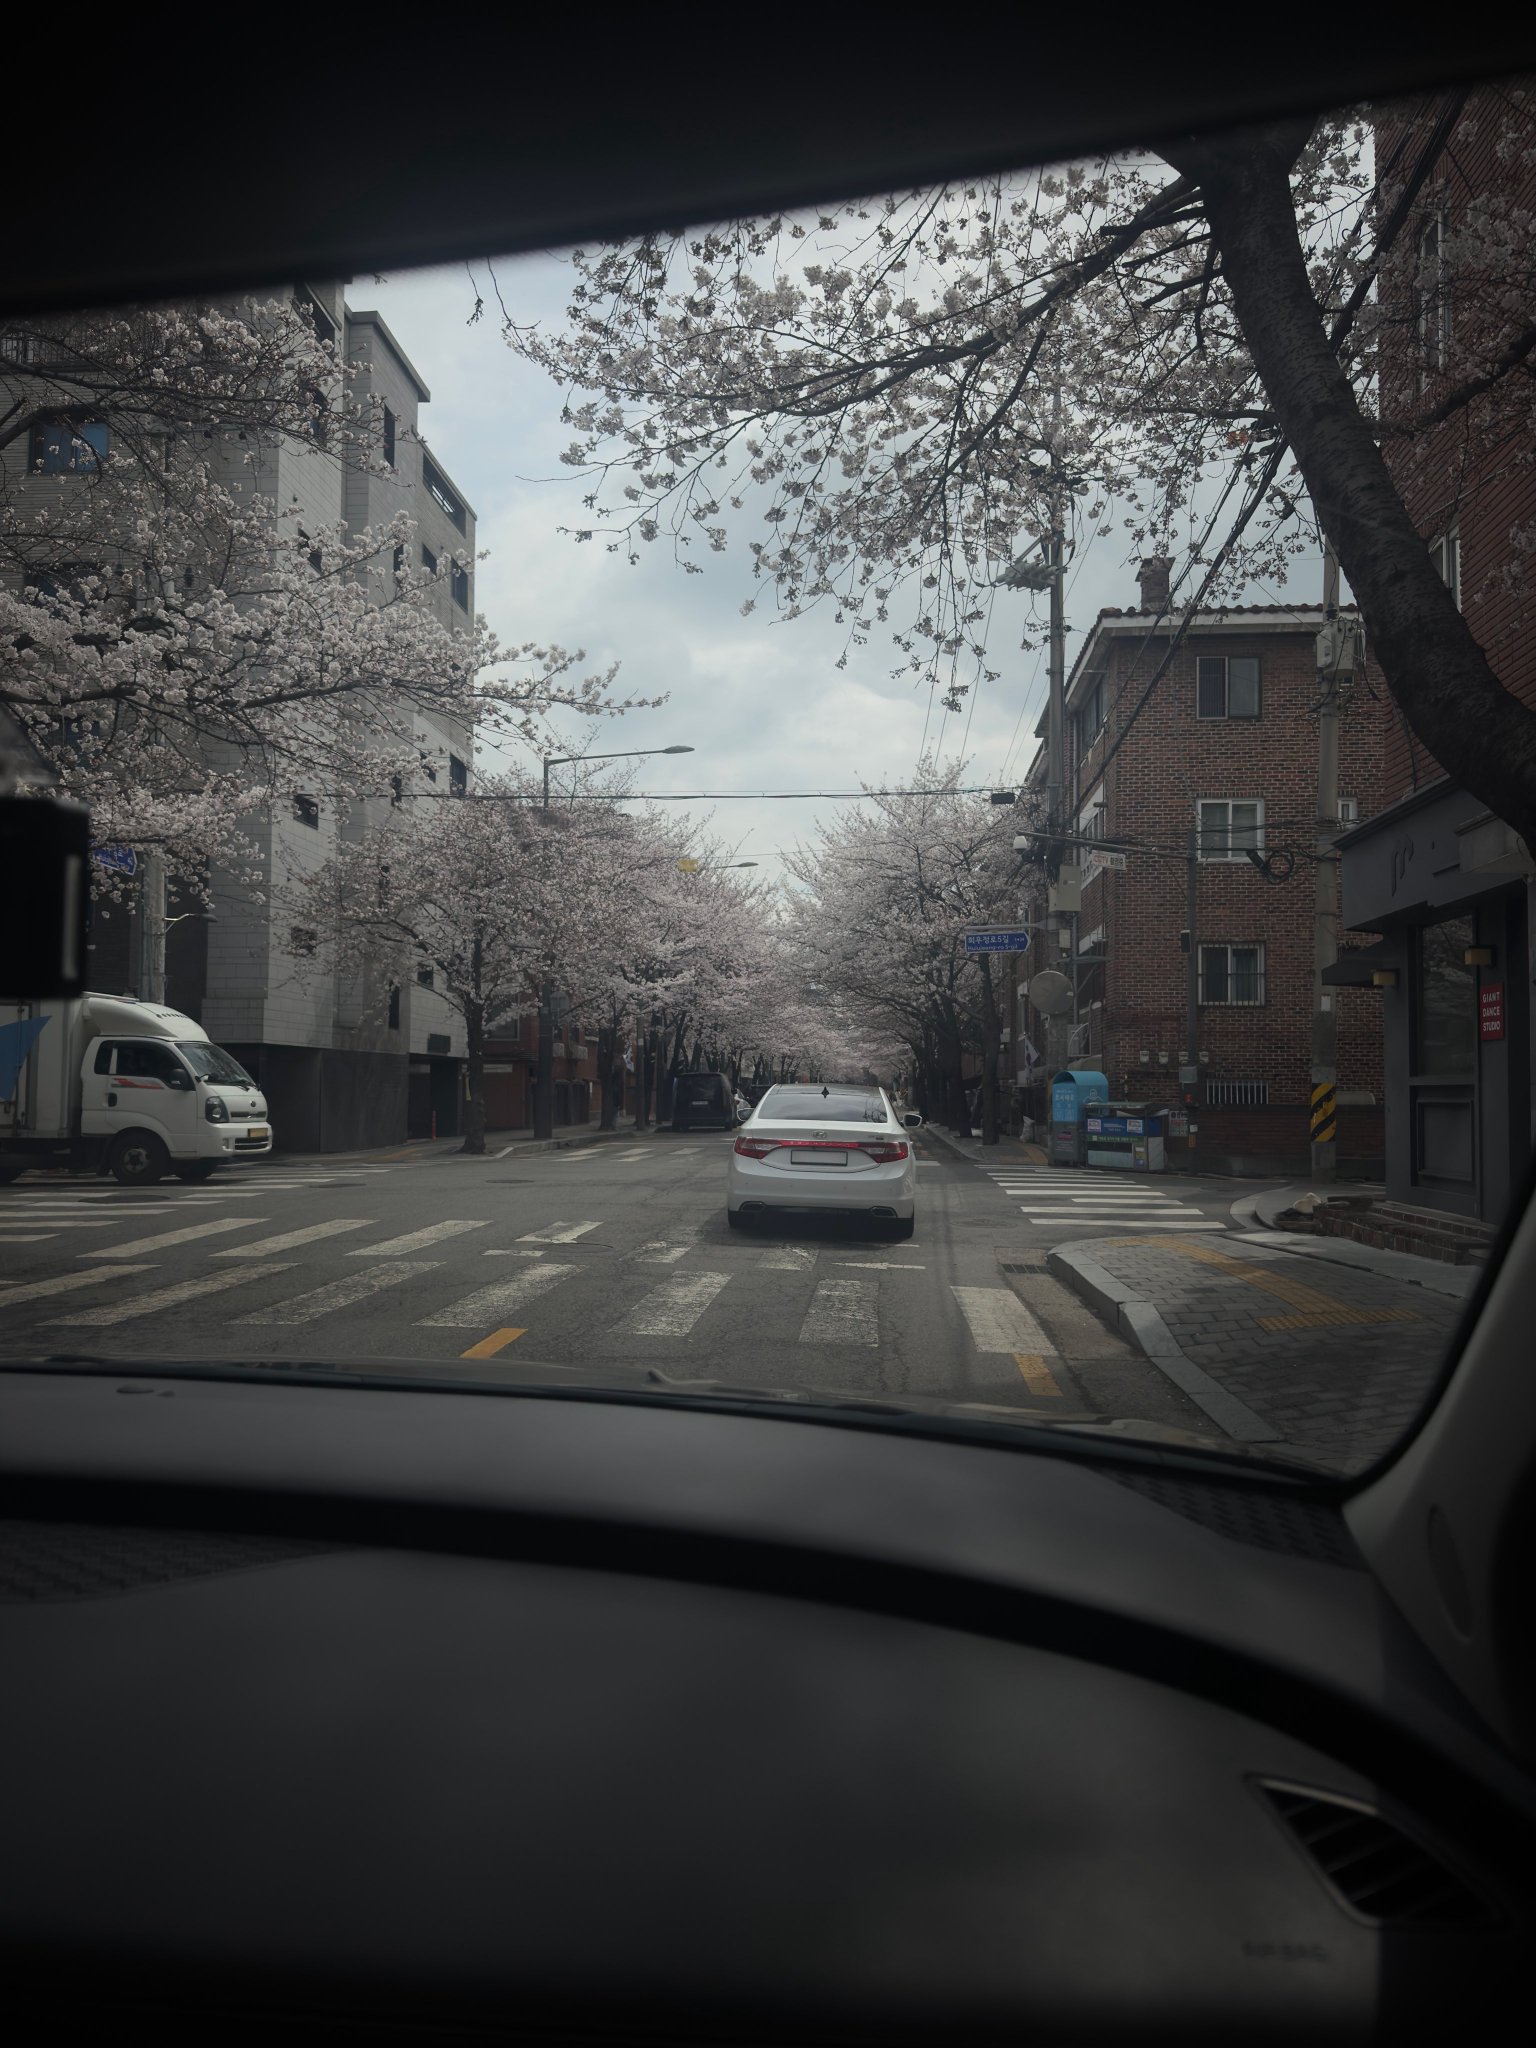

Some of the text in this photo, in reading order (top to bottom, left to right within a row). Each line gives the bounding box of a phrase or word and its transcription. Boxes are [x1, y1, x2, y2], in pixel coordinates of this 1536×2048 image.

[1483, 992, 1500, 1003] GIANT
[1483, 1006, 1500, 1017] DANCE
[1483, 1020, 1501, 1031] STUDIO
